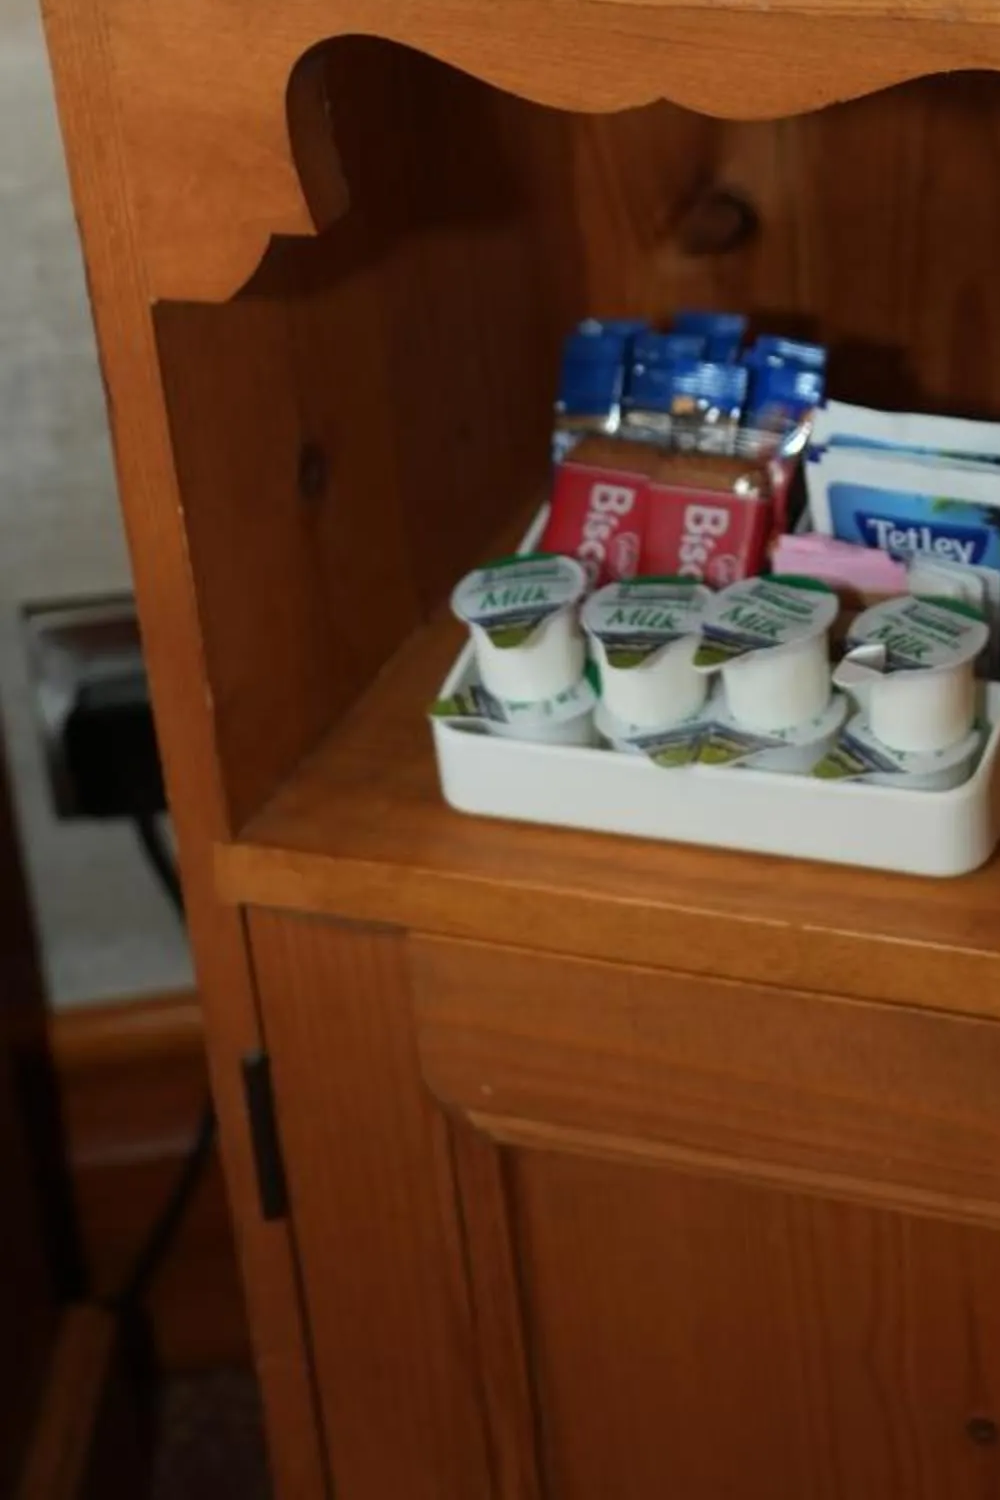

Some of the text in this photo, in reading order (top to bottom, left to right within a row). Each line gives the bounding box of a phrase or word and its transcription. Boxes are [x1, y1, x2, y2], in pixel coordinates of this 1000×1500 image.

[867, 518, 975, 564] Tetley
[479, 583, 551, 609] Milk
[604, 606, 681, 631] Milk
[719, 604, 785, 637] Milk
[866, 622, 931, 659] Milk
